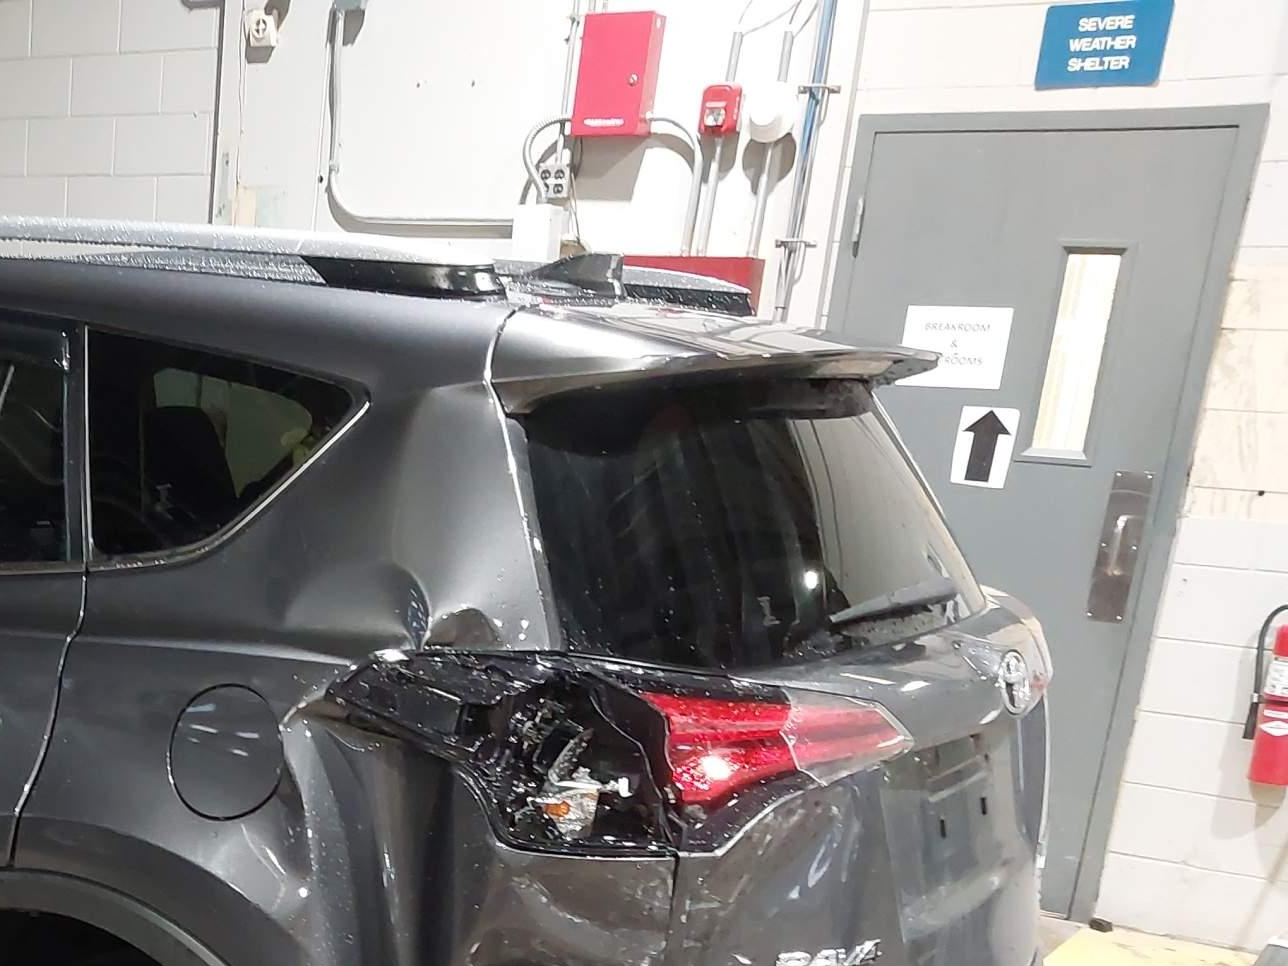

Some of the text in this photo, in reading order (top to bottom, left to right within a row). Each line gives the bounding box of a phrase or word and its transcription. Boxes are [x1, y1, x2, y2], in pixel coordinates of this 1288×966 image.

[1078, 15, 1135, 31] SEVERE
[1069, 35, 1137, 52] WEATHER
[1067, 56, 1130, 72] SHELTER
